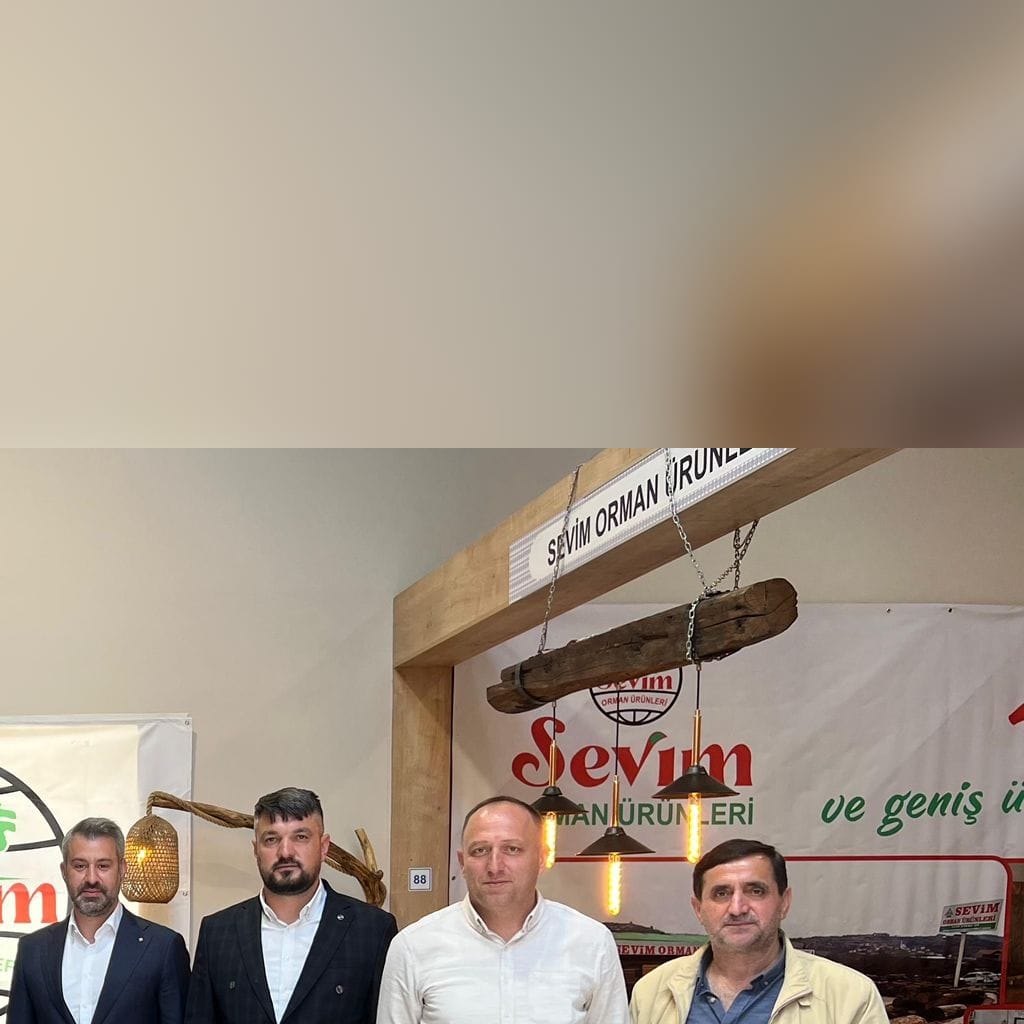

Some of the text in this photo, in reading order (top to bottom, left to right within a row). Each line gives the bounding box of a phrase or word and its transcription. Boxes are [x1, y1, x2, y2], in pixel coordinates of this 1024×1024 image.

[548, 516, 591, 566] SEVİM
[595, 475, 659, 537] ORMAN
[601, 694, 668, 707] ORMAN ÜRÜNLERİ
[511, 716, 753, 788] Sevim
[618, 797, 754, 826] ÜRÜNERİ
[821, 794, 866, 824] ve
[876, 781, 984, 837] geniş
[413, 874, 427, 885] 88
